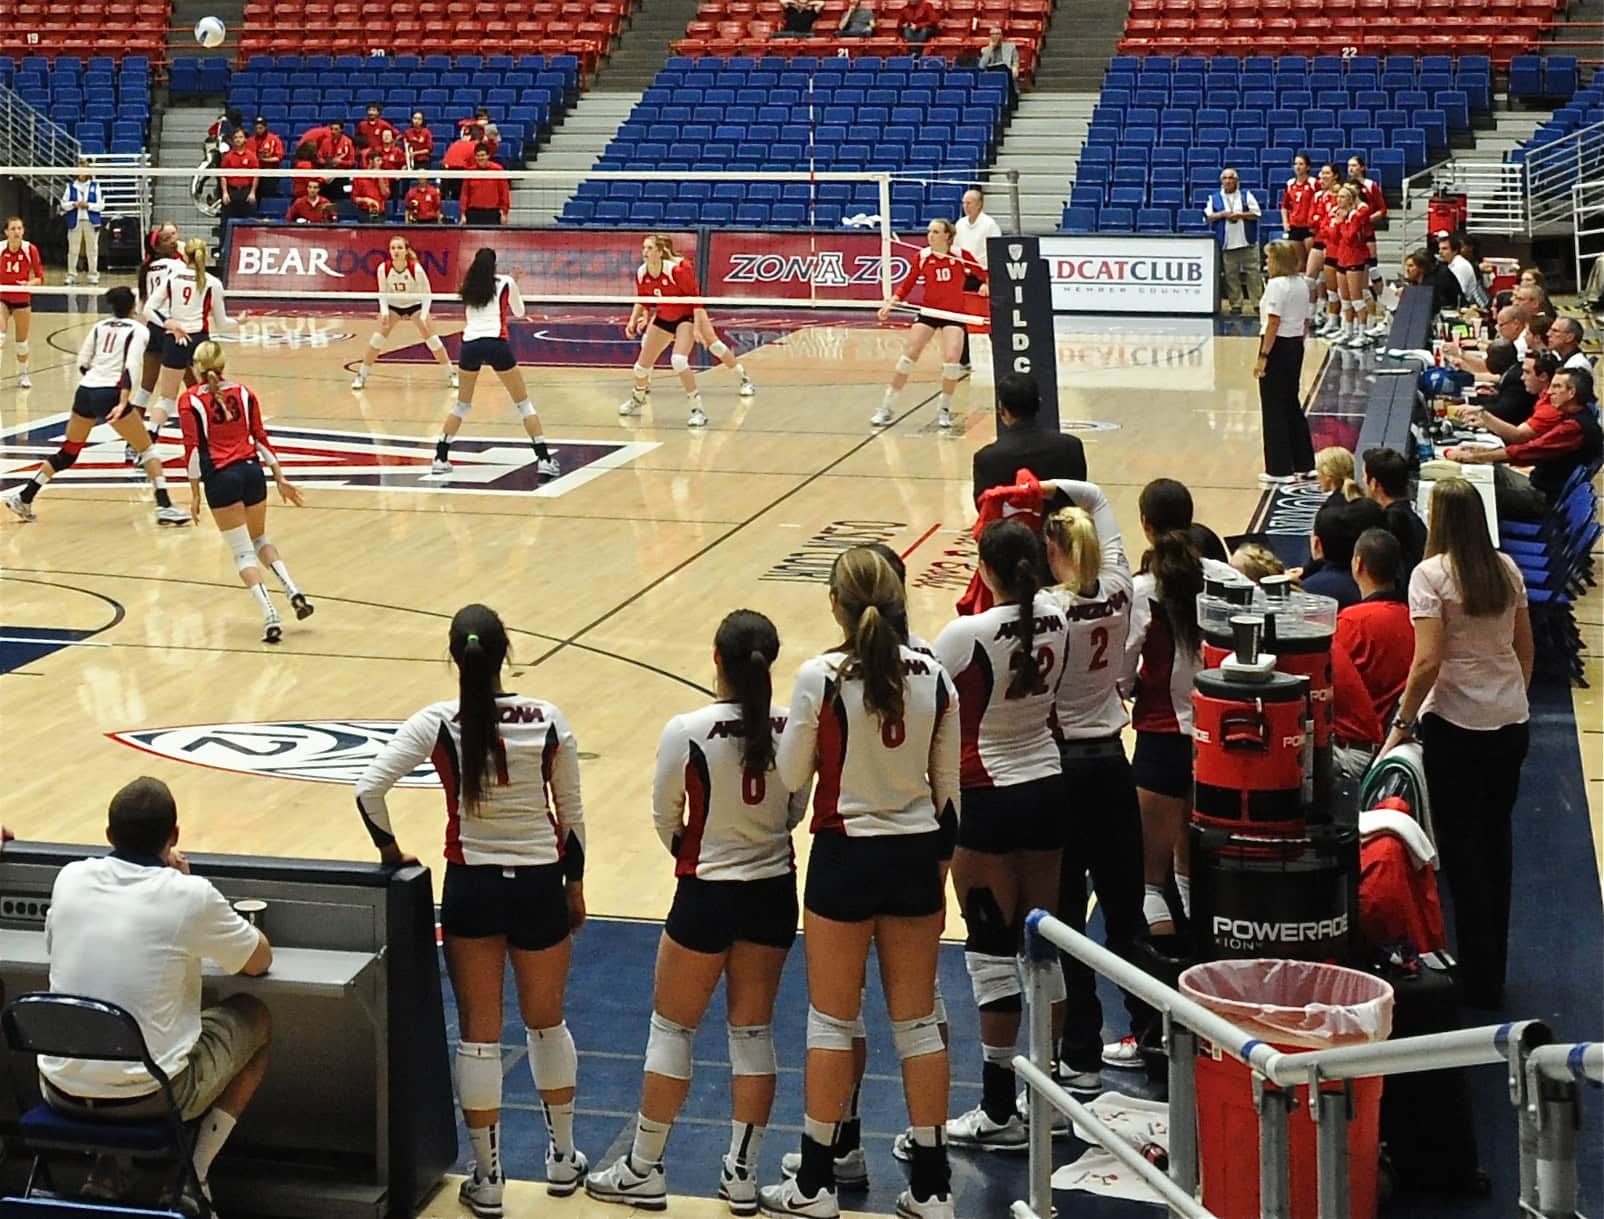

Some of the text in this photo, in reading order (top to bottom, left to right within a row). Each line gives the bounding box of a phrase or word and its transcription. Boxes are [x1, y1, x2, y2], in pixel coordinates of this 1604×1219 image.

[27, 33, 39, 44] 19
[837, 48, 849, 58] 21
[1342, 46, 1358, 58] 22
[6, 261, 20, 273] 14
[237, 246, 449, 277] BEAR DON
[723, 251, 849, 288] ZONA
[1051, 259, 1203, 281] DCATCLUB
[935, 267, 951, 282] 10
[183, 286, 192, 306] 9
[102, 332, 117, 353] 11
[1088, 626, 1109, 672] 2
[1213, 912, 1348, 941] POWERADE
